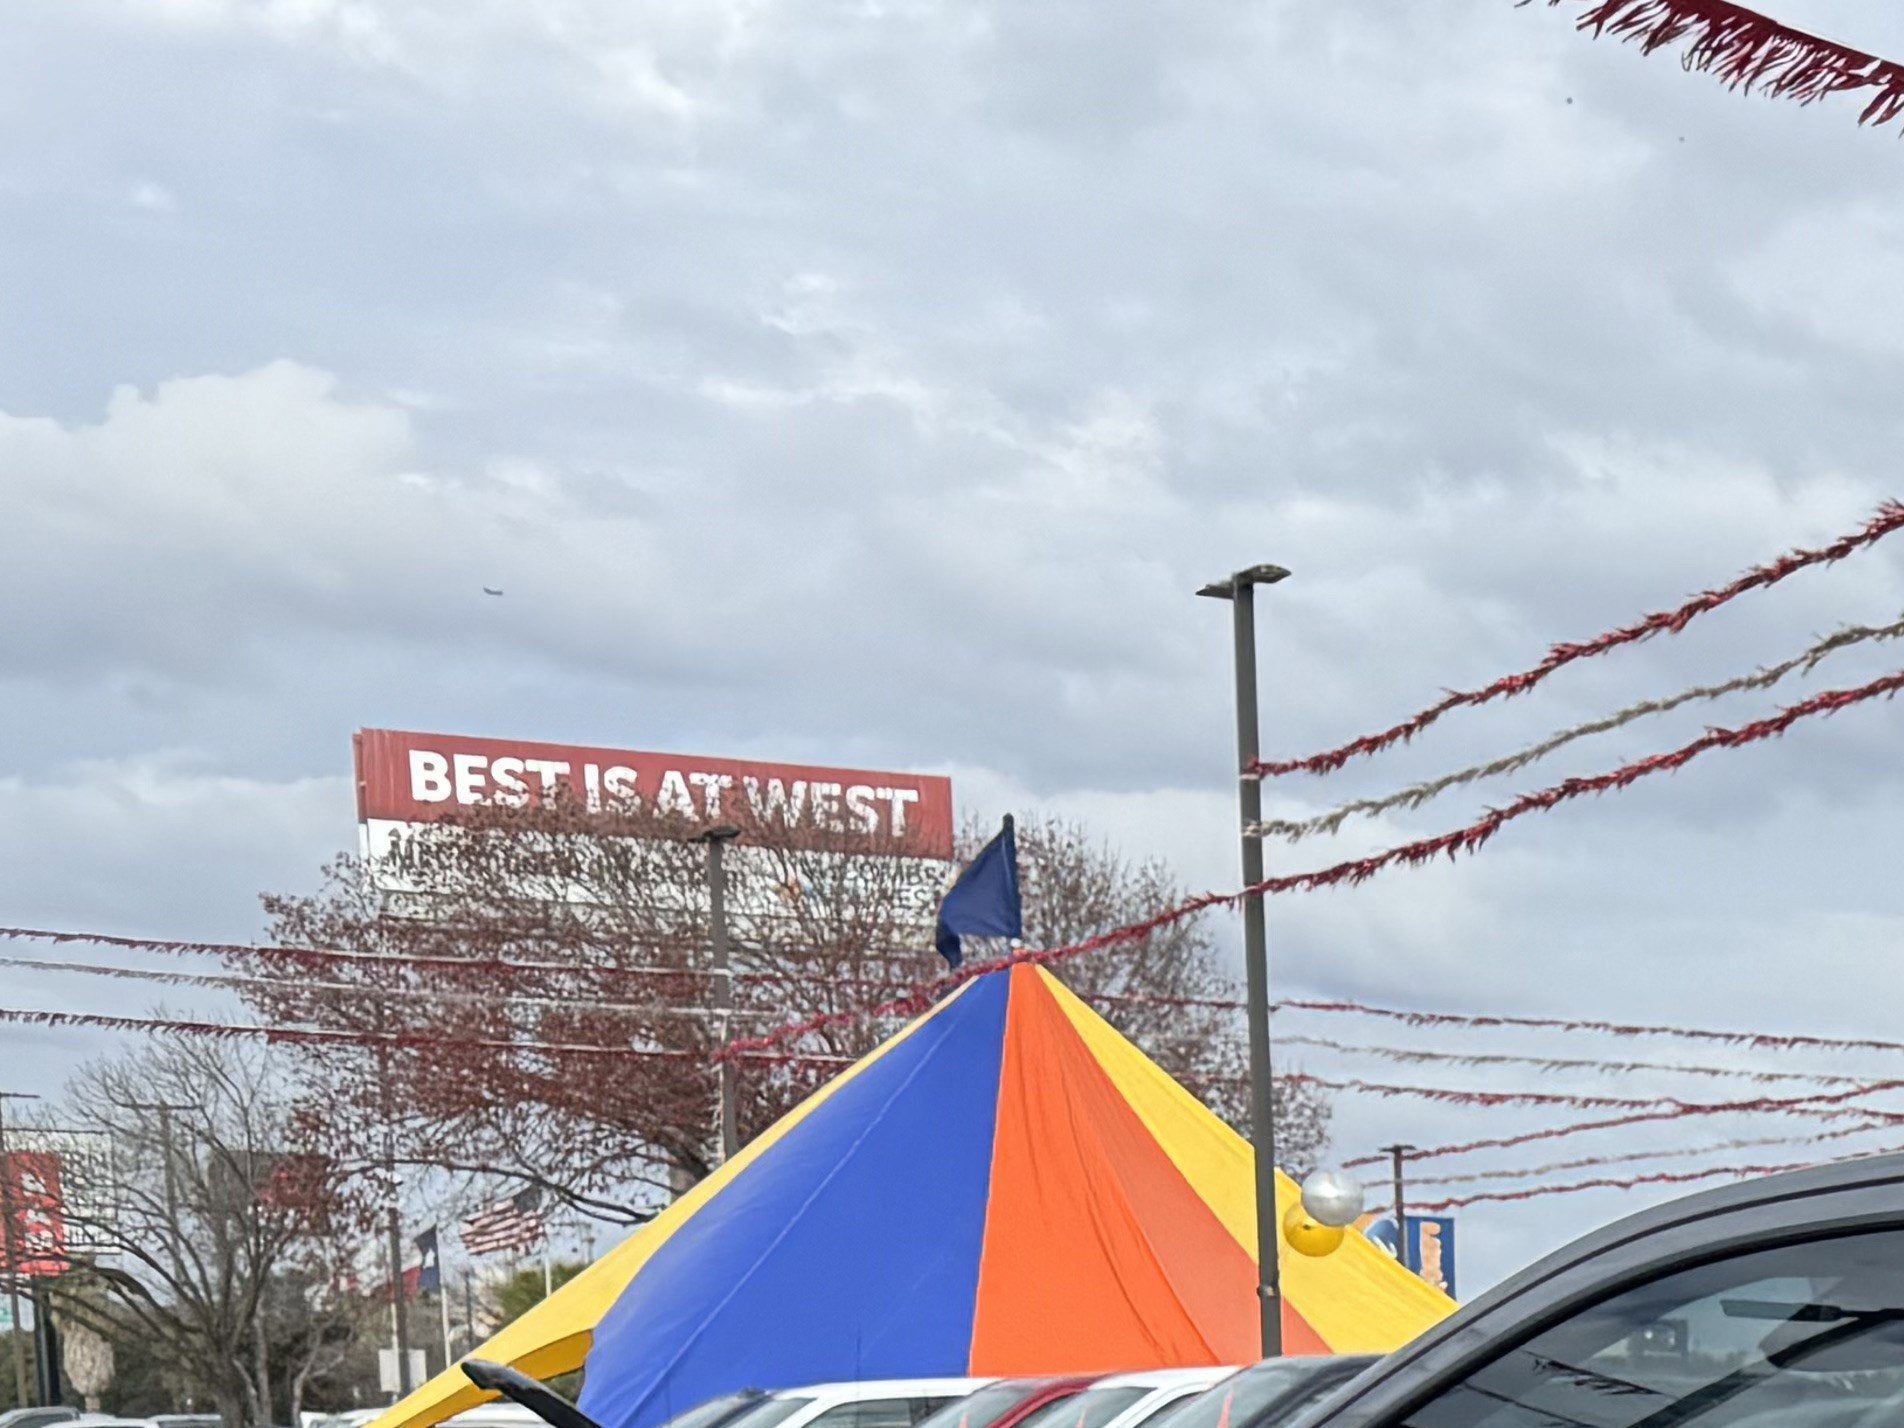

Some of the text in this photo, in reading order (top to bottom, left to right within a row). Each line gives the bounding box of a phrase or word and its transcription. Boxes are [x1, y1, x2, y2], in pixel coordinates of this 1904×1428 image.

[408, 749, 919, 838] BEST IS AT WEST
